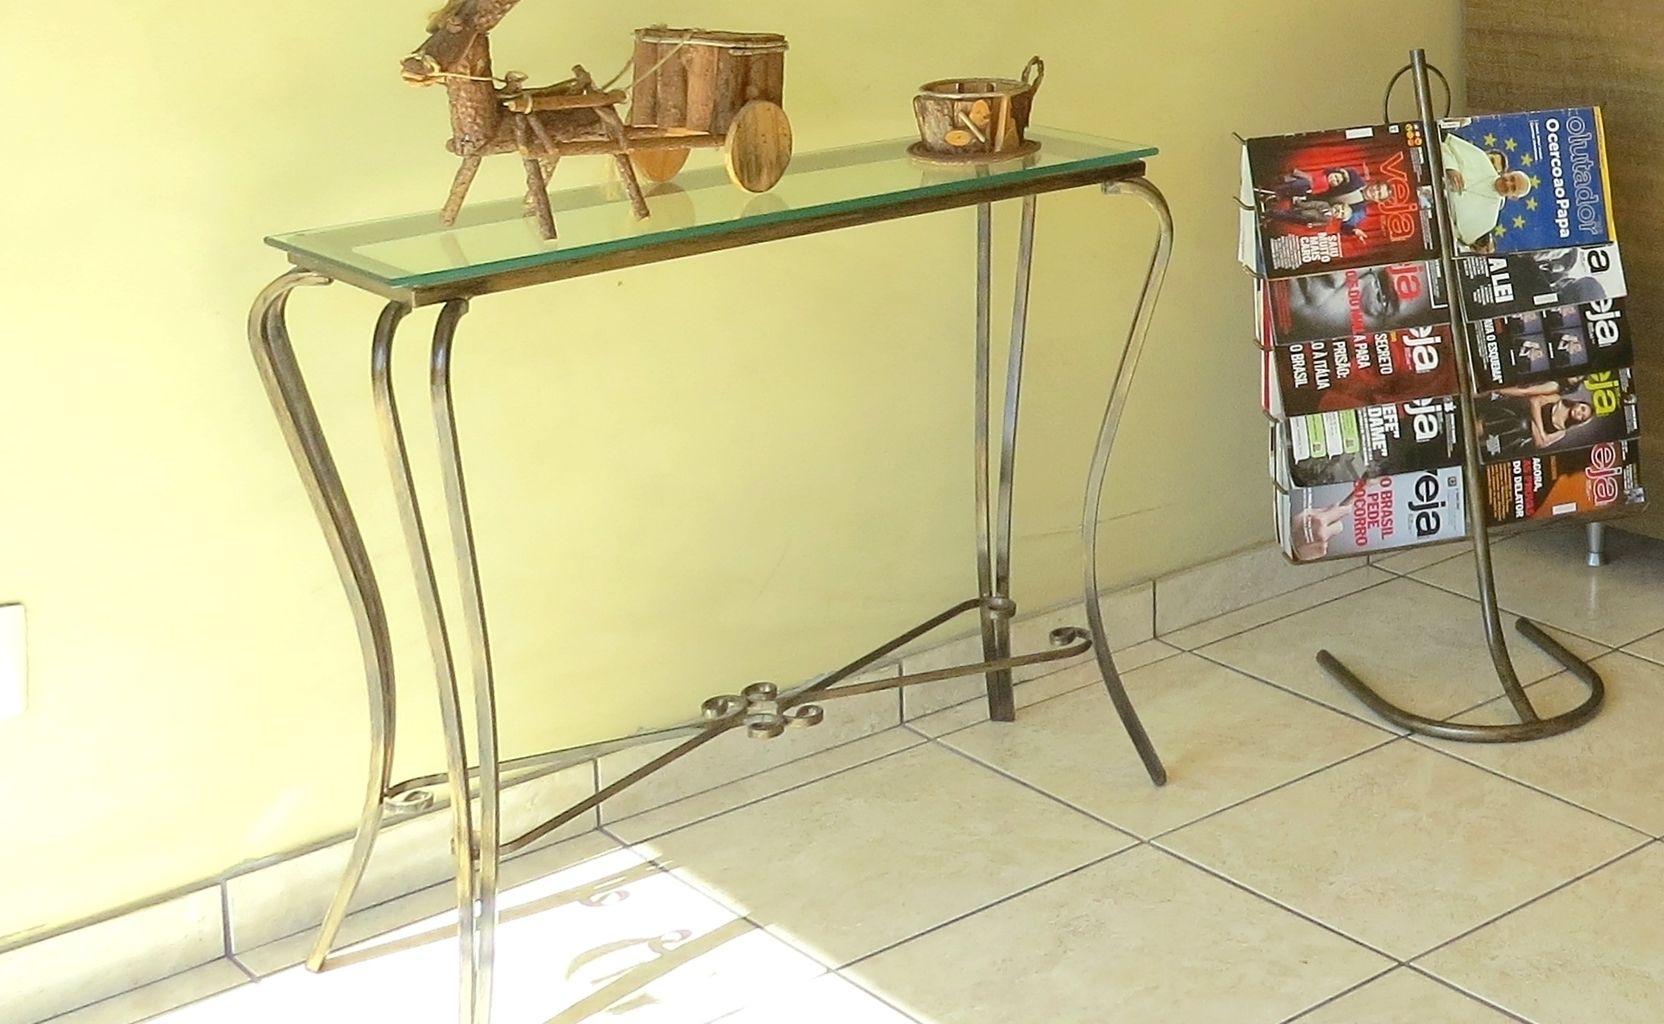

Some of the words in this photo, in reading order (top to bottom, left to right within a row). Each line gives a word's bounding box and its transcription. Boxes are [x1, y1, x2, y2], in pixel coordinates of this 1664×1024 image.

[1545, 118, 1559, 133] O
[1548, 133, 1563, 178] cerco
[1379, 151, 1417, 242] veja
[1553, 178, 1566, 198] ao
[1554, 199, 1570, 238] Papa
[1299, 236, 1311, 263] CARO
[1309, 236, 1321, 261] MAIS
[1317, 233, 1331, 263] MUITO
[1326, 234, 1339, 257] SAIU
[1585, 247, 1611, 274] a
[1487, 257, 1509, 272] A
[1388, 263, 1425, 302] ja
[1491, 273, 1514, 303] LEI
[1332, 341, 1351, 379] PRISÃO:
[1353, 343, 1369, 369] PARA
[1374, 333, 1393, 375] SECRETO
[1290, 353, 1309, 388] BRASIL
[1313, 361, 1332, 390] ITÁLIA
[1512, 460, 1522, 474] DO
[1380, 478, 1392, 488] O
[1513, 476, 1525, 518] DELATOR
[1367, 493, 1380, 528] PEDE
[1380, 491, 1394, 540] BRASIL
